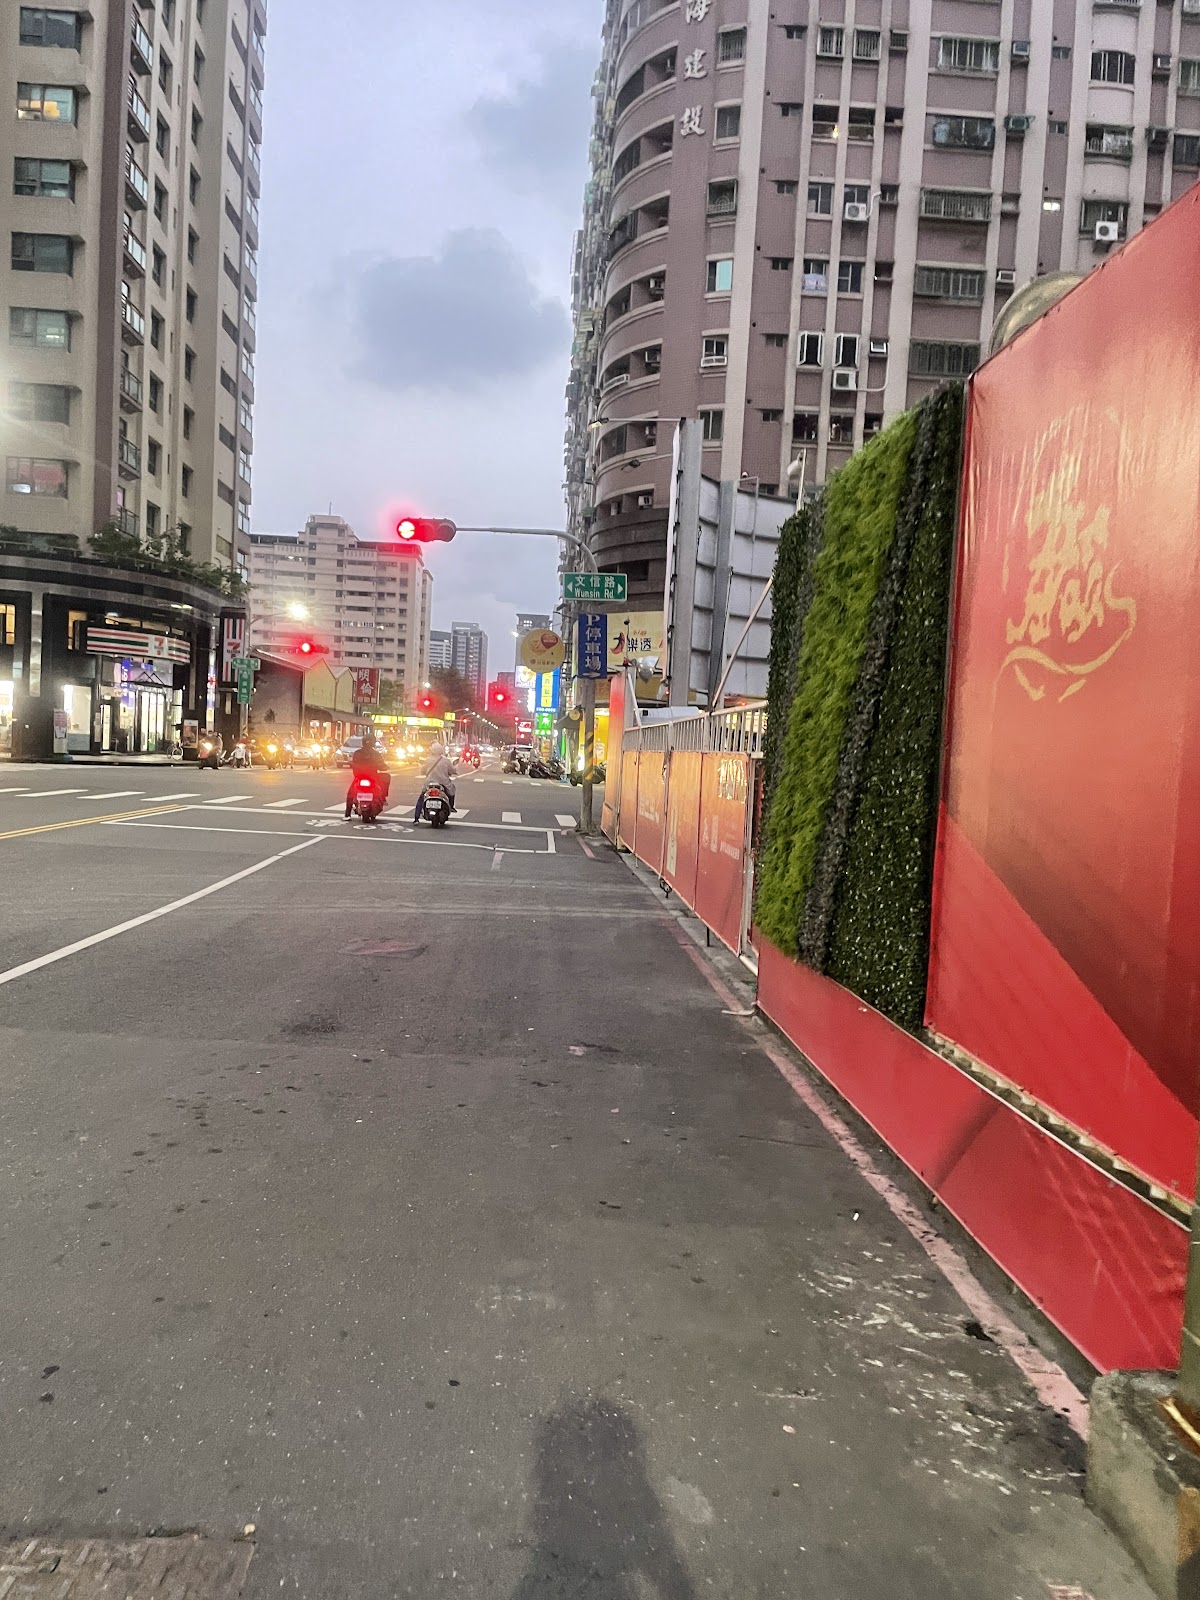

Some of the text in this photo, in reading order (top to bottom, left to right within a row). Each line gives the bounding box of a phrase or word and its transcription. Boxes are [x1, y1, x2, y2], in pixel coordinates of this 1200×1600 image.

[575, 576, 615, 588] 文信路
[574, 588, 600, 598] Wunsin
[587, 614, 600, 626] P
[585, 626, 601, 670] 停車場
